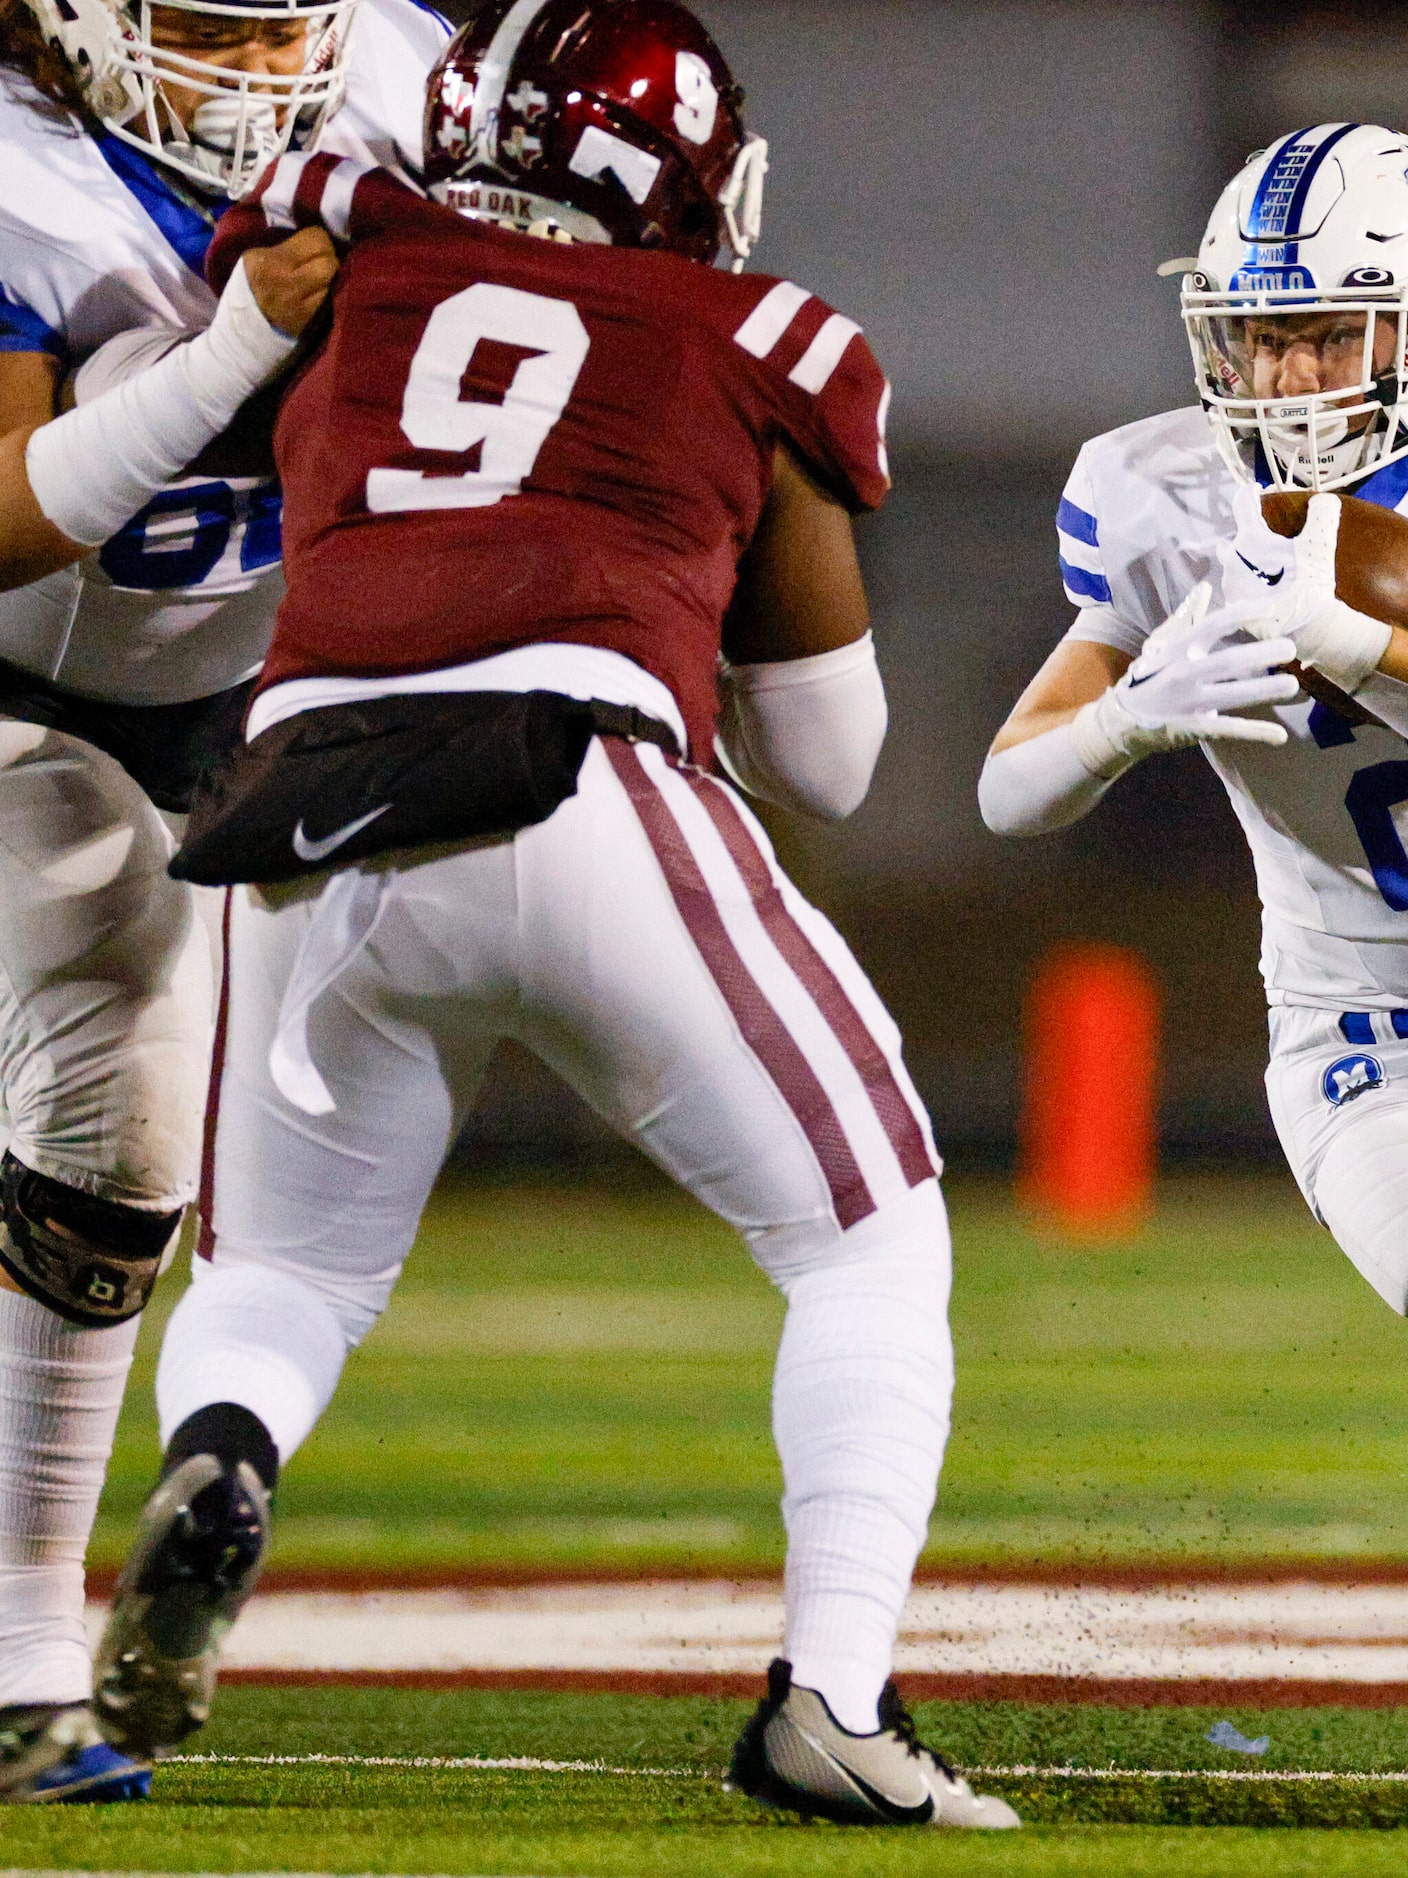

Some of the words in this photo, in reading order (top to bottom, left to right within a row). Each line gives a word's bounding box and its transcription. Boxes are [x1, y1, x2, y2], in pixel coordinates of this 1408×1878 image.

[1265, 191, 1293, 204] WIN
[488, 192, 532, 220] OAK
[1261, 204, 1289, 218] WIN
[1259, 218, 1284, 232] WIN
[1258, 247, 1284, 262] WIN
[366, 282, 591, 513] 9
